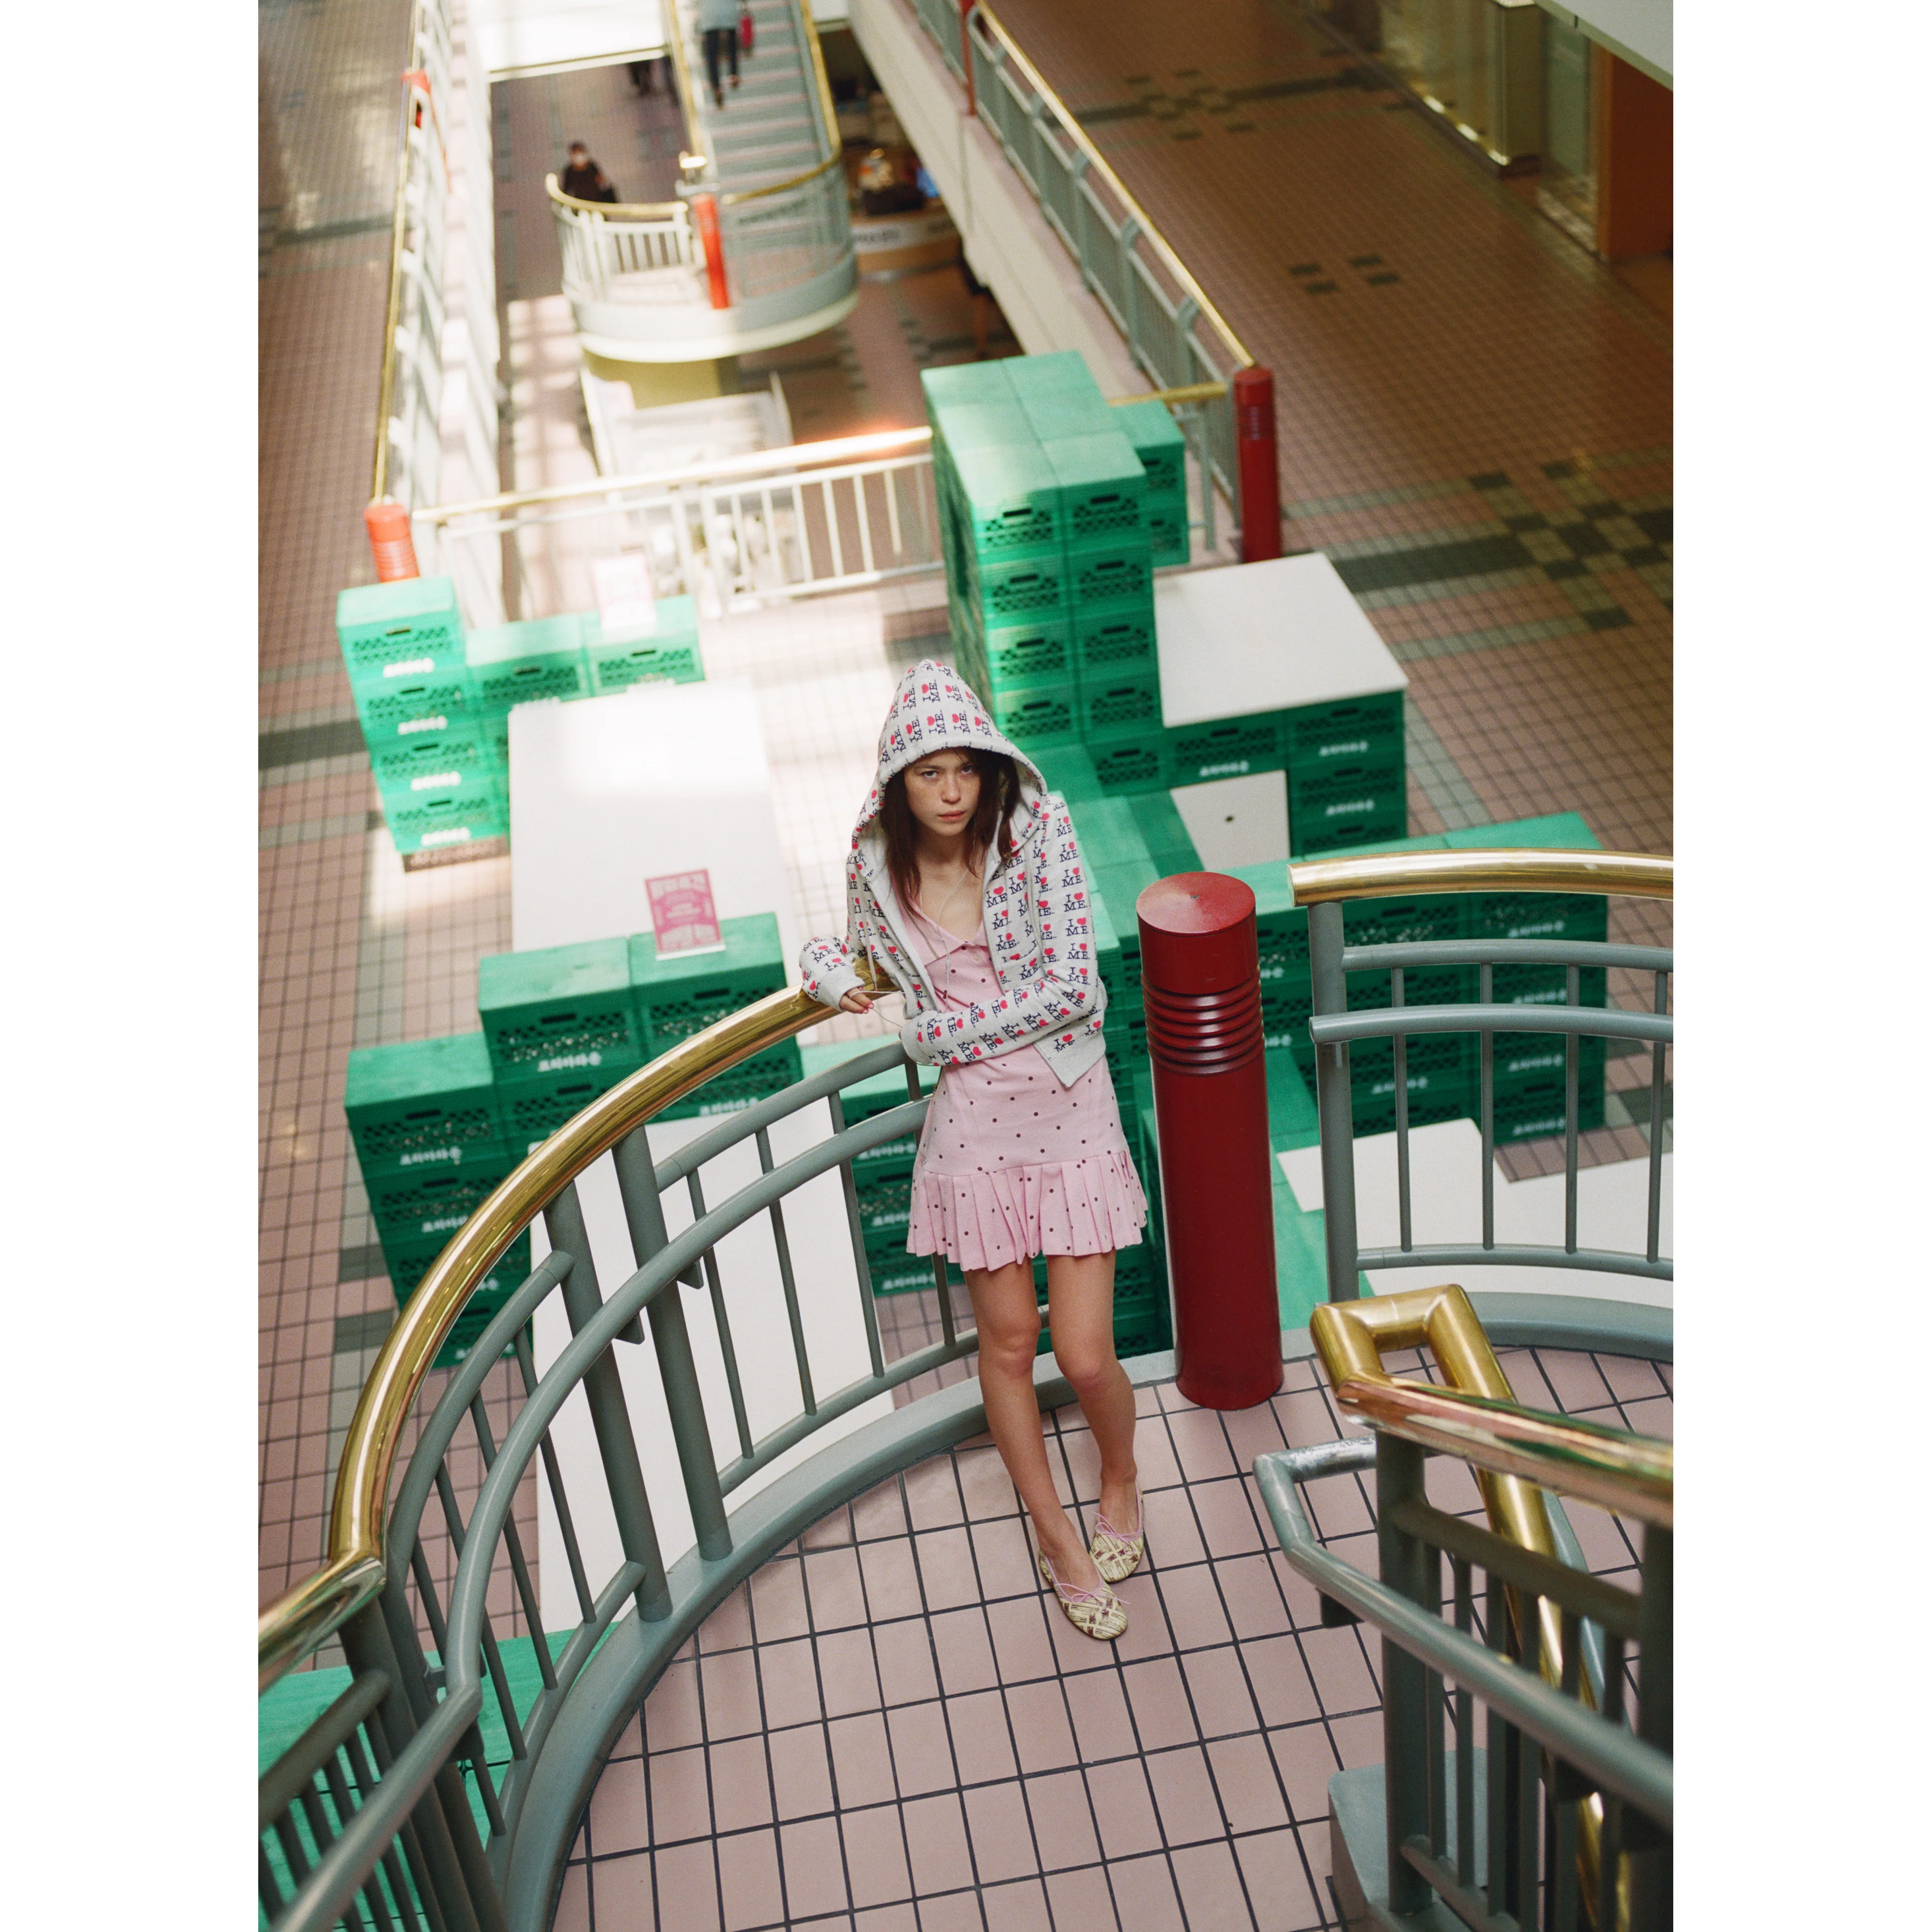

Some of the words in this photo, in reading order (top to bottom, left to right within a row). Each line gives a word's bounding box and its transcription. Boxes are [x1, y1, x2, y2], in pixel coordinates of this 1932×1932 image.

[908, 688, 916, 710] ME
[929, 683, 940, 703] ME
[952, 684, 963, 703] ME
[912, 718, 922, 742] ME
[935, 713, 947, 735] ME
[959, 713, 971, 733] ME
[894, 729, 907, 752] ME
[1057, 818, 1062, 827] I
[1056, 824, 1072, 837] ME
[1060, 850, 1079, 862] ME
[1061, 844, 1066, 853] I
[1009, 876, 1016, 885] I
[1062, 875, 1082, 887] ME
[1064, 869, 1069, 878] I
[1009, 878, 1027, 894] ME
[986, 891, 992, 899] I
[986, 893, 1008, 908] ME
[1066, 894, 1071, 903] I
[1064, 900, 1086, 912] ME
[994, 913, 1000, 921] I
[1068, 919, 1073, 927] I
[1066, 926, 1088, 936] ME
[996, 939, 1017, 951] ME
[813, 949, 834, 964] ME
[1019, 964, 1038, 980] ME
[1021, 964, 1027, 973] I
[1068, 974, 1088, 984] ME
[1013, 988, 1022, 1006] ME
[1061, 991, 1083, 1007] ME
[970, 1005, 979, 1024] ME
[1044, 1003, 1064, 1022] ME
[927, 1017, 935, 1041] ME
[1023, 1014, 1042, 1031] ME
[979, 1033, 998, 1051] ME
[957, 1042, 976, 1061] ME
